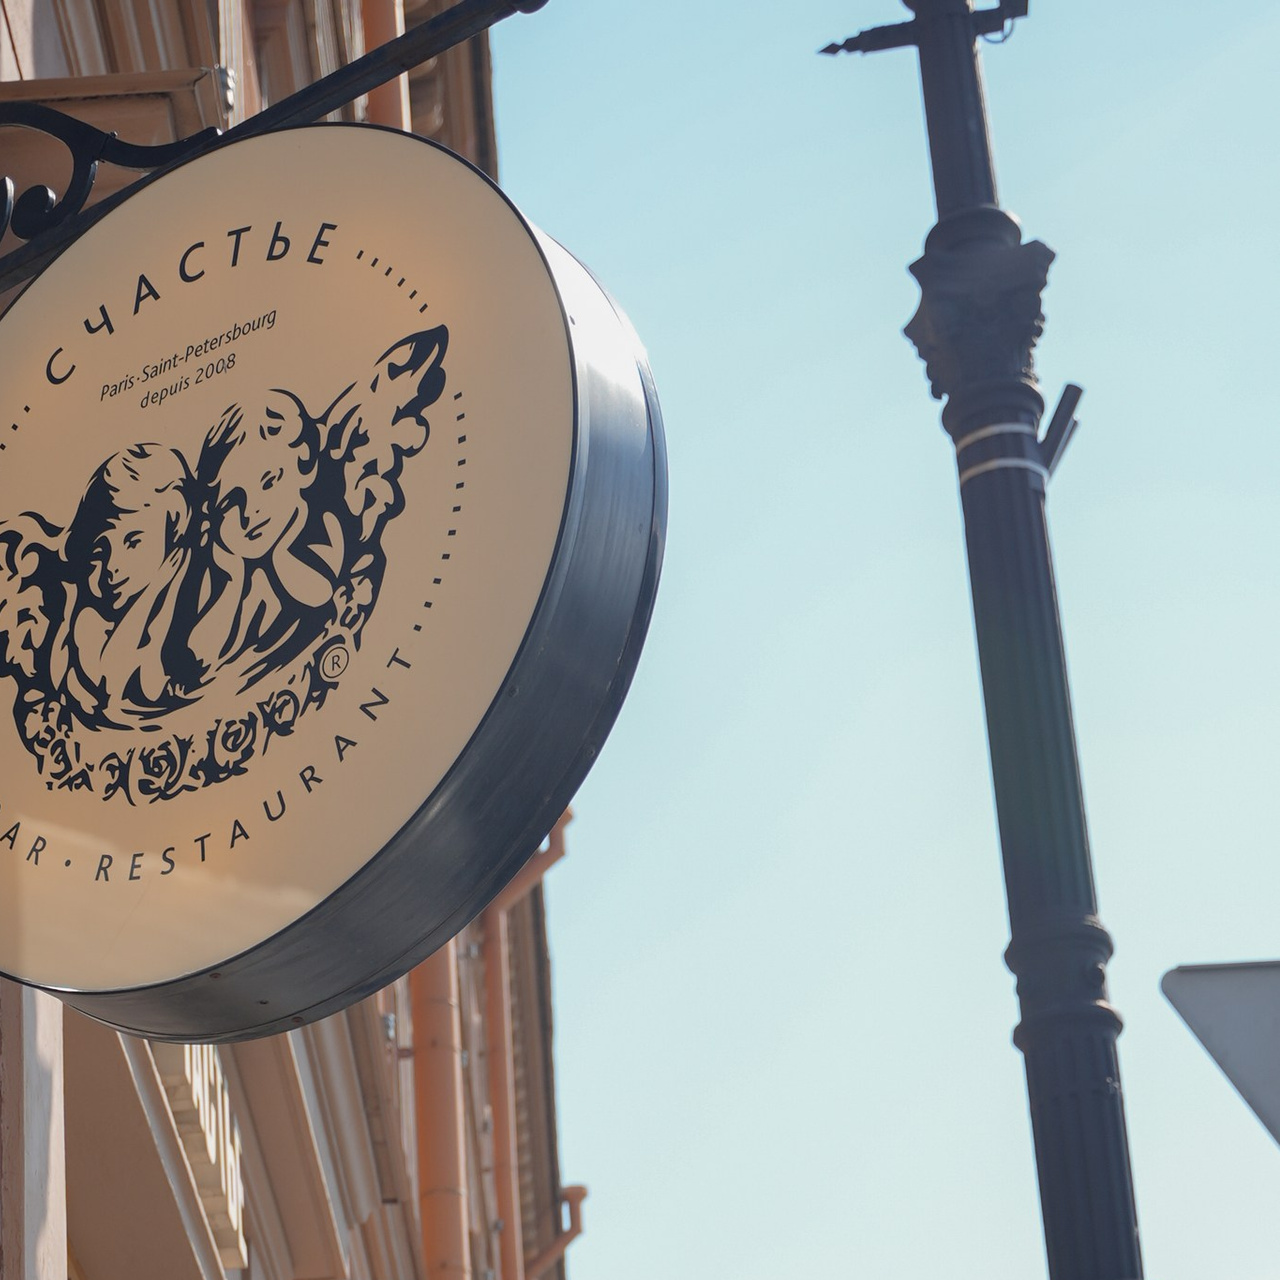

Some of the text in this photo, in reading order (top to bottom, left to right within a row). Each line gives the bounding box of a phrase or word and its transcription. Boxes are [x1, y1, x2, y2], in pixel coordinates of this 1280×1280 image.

[45, 221, 338, 386] СЧАСТЬЕ
[140, 352, 237, 409] depuis 2008
[94, 646, 412, 882] RESTAURANT
[183, 1044, 248, 1268] АСТЬЕ
